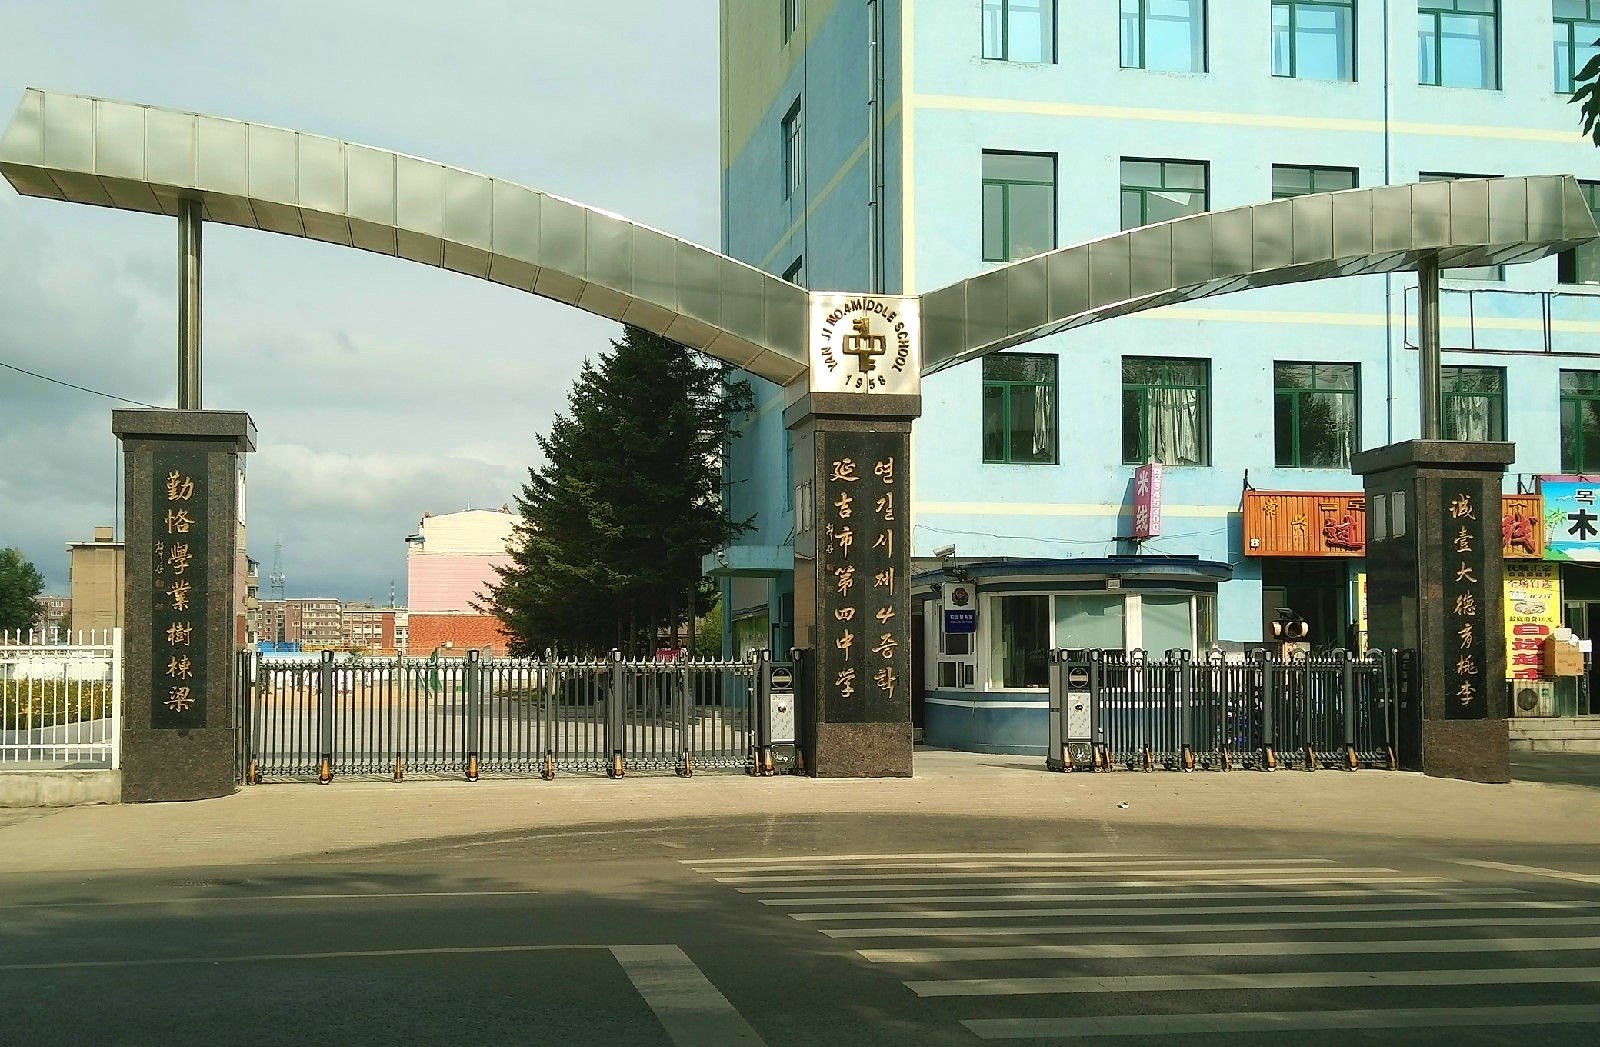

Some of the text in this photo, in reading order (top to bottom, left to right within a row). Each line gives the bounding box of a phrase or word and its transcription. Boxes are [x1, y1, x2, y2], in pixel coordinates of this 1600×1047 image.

[821, 327, 833, 341] JI
[892, 321, 909, 373] SCHOOL
[821, 346, 838, 373] YAN
[845, 374, 886, 390] 1956
[1574, 489, 1596, 506] 목
[1567, 508, 1599, 541] 木
[830, 457, 861, 698] 延吉市第四中学
